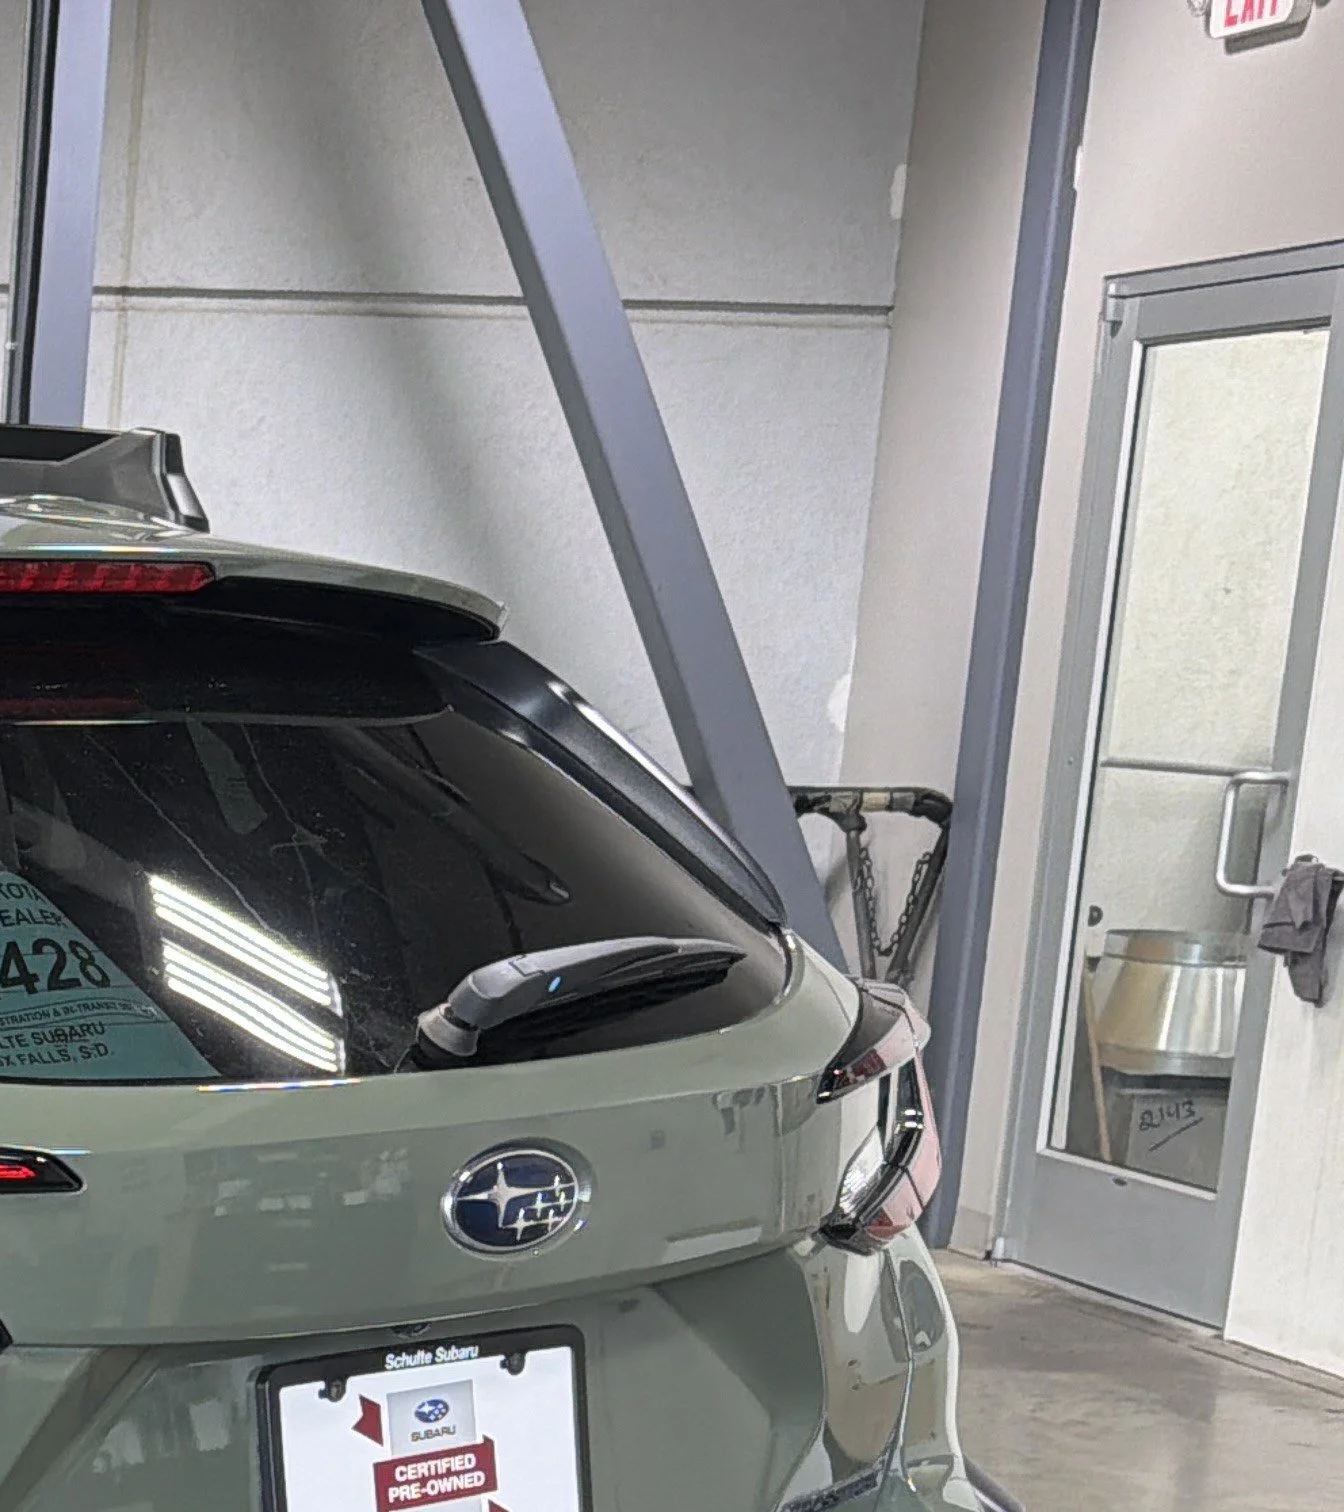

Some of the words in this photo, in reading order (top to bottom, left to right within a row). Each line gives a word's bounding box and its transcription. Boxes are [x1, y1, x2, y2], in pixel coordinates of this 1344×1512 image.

[31, 1020, 106, 1046] SUBARU
[16, 1048, 78, 1066] FALLS,
[385, 1347, 432, 1371] Schulte
[435, 1344, 479, 1365] Subaru
[410, 1425, 457, 1443] SUBARU
[394, 1453, 476, 1482] CERTIFIED
[388, 1471, 486, 1504] PRE-OWNED
